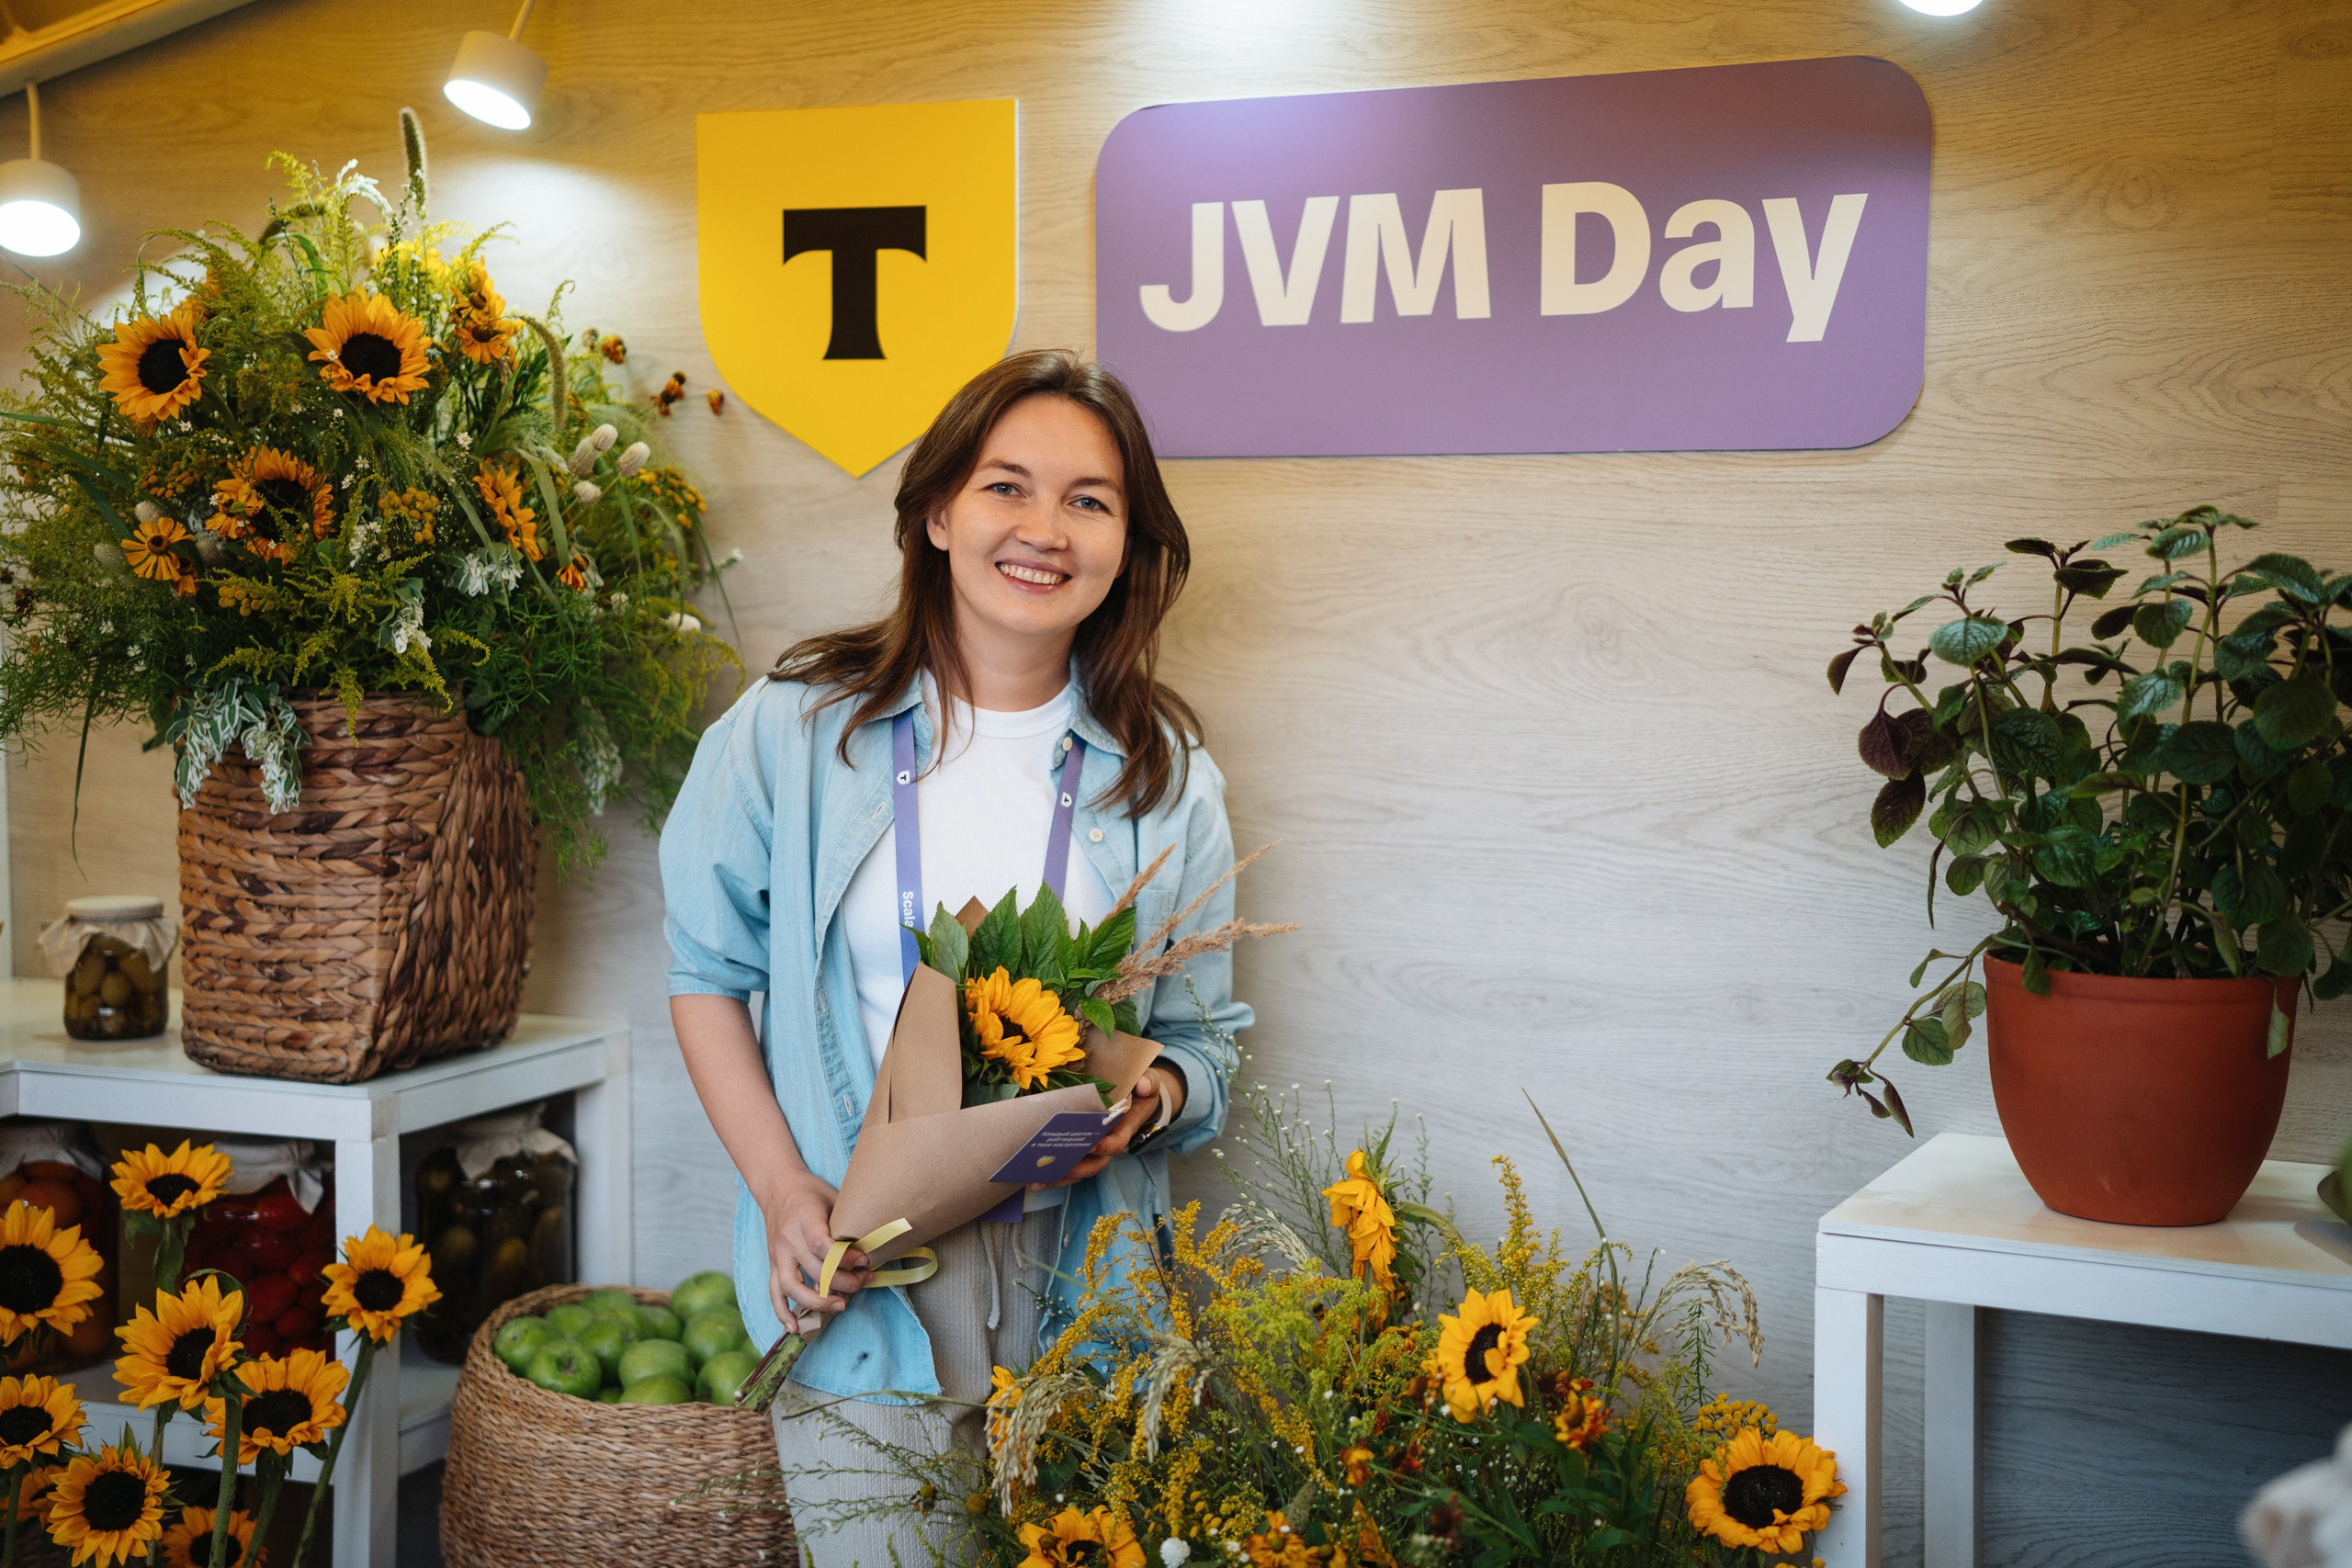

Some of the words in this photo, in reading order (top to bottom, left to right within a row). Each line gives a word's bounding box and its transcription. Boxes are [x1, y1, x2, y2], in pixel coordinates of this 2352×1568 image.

[783, 205, 928, 361] T
[1139, 187, 1491, 333] JVM
[1541, 181, 1869, 343] Day
[902, 891, 916, 928] Scala
